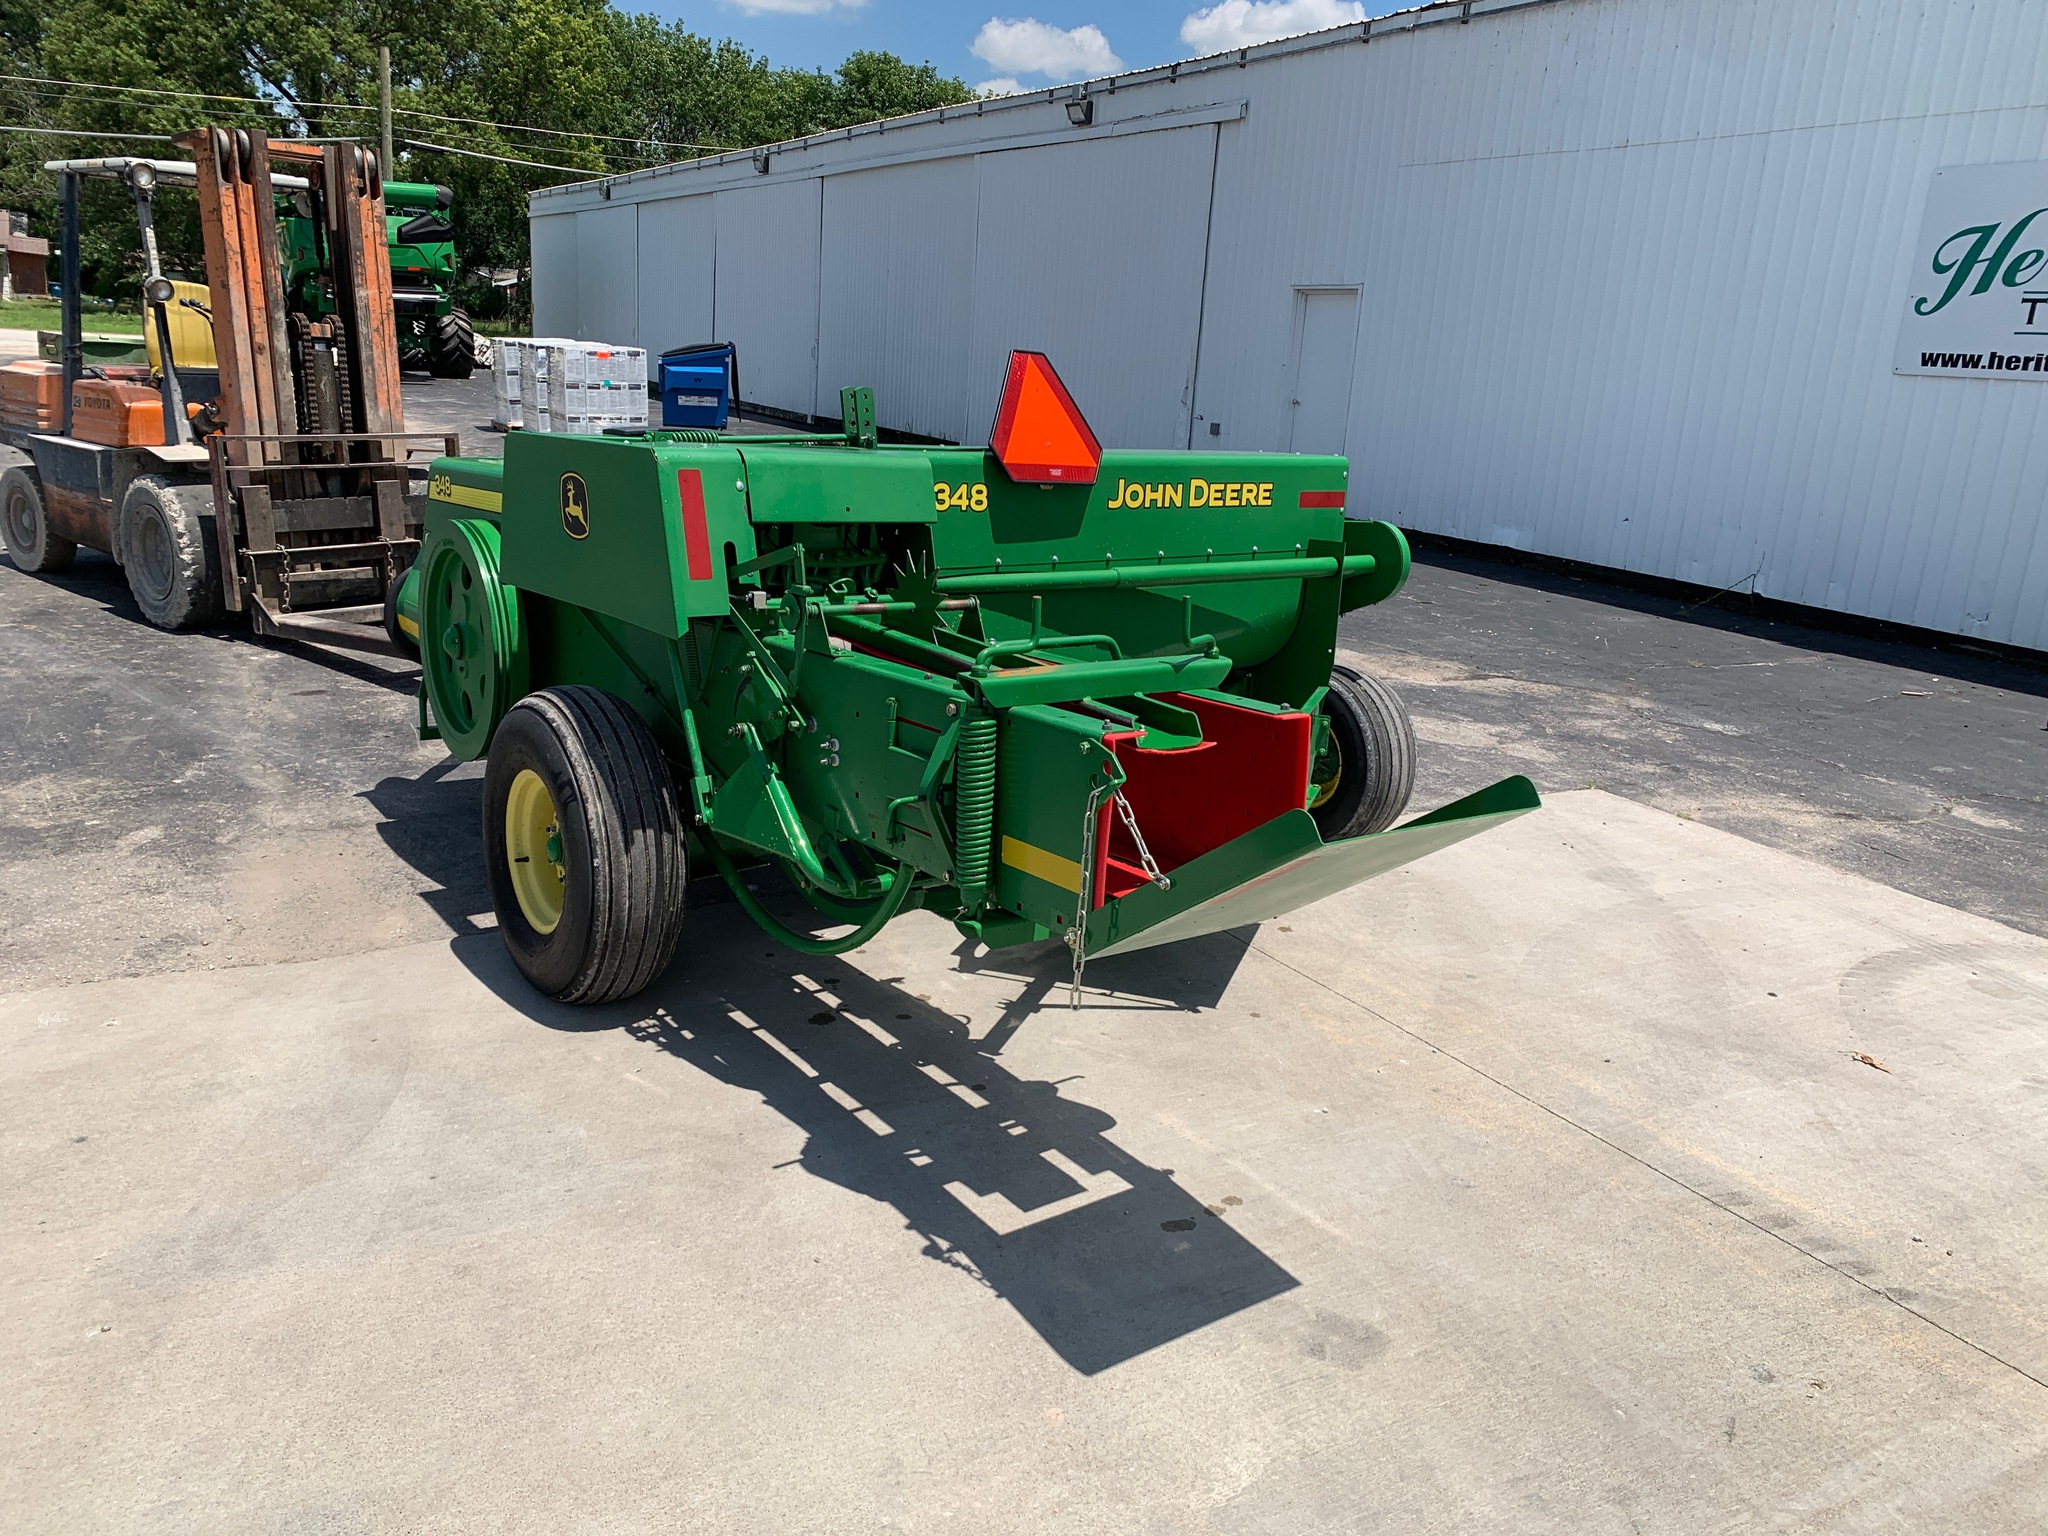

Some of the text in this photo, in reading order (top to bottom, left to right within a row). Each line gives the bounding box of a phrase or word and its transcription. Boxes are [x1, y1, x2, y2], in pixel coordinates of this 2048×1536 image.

[1914, 207, 2048, 316] He
[84, 396, 111, 410] TOYOTA
[434, 474, 452, 497] 348
[934, 482, 989, 512] 348
[1107, 477, 1274, 510] JOHN DEERE
